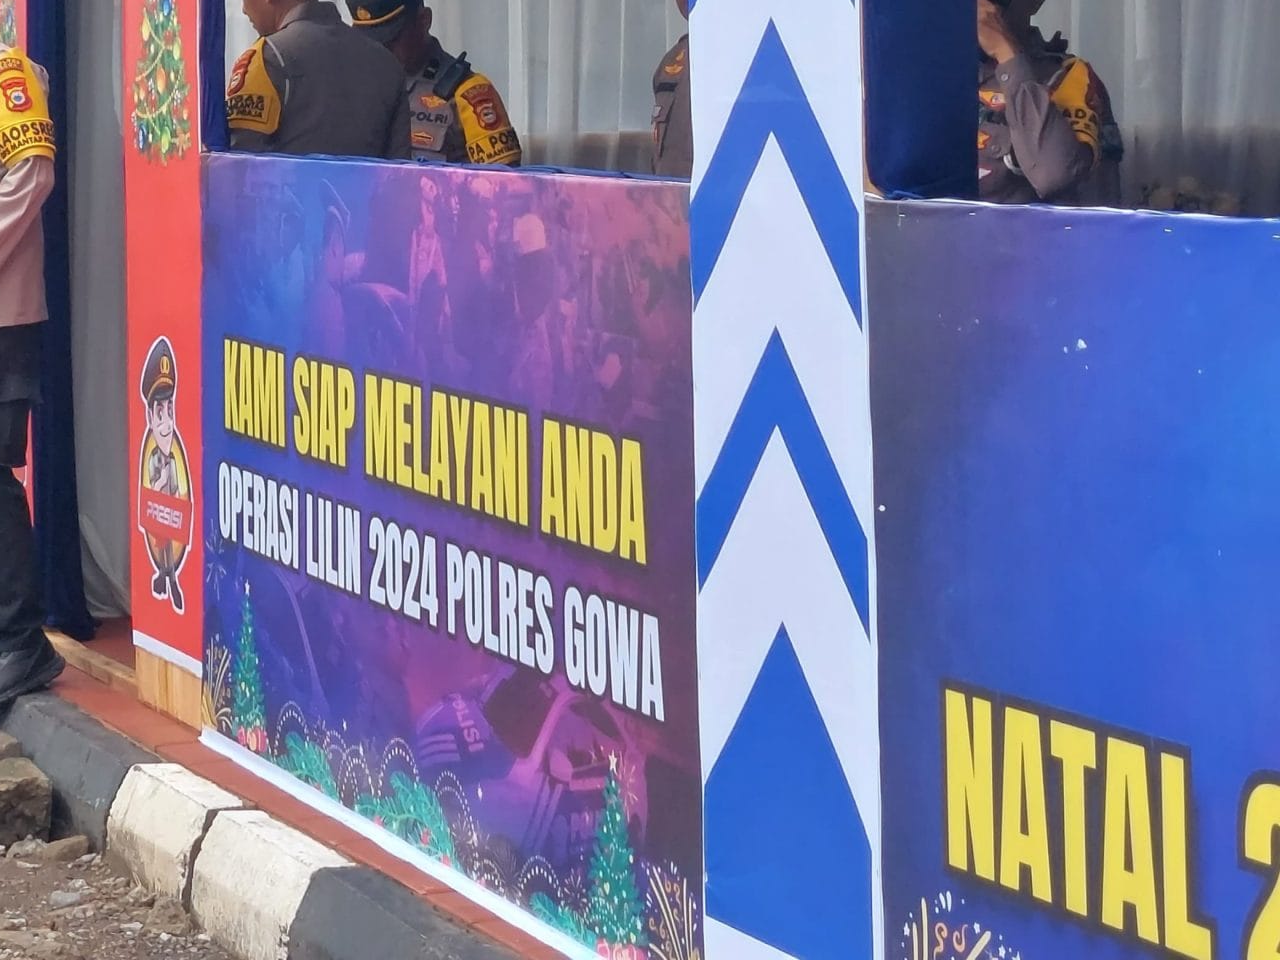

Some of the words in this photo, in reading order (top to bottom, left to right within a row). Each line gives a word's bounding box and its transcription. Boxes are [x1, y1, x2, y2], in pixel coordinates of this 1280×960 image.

[410, 111, 448, 124] POLRI
[147, 501, 183, 529] PRESISI
[223, 338, 285, 448] KAMI
[293, 357, 355, 468] SIAP
[364, 374, 529, 526] MELAYANI
[541, 419, 646, 566] ANDA
[218, 462, 299, 569] OPERASI
[306, 493, 361, 594] LILIN
[369, 517, 439, 627] 2024
[446, 542, 554, 675] POLRES
[564, 586, 665, 722] GOWA
[945, 688, 1212, 960] NATAL
